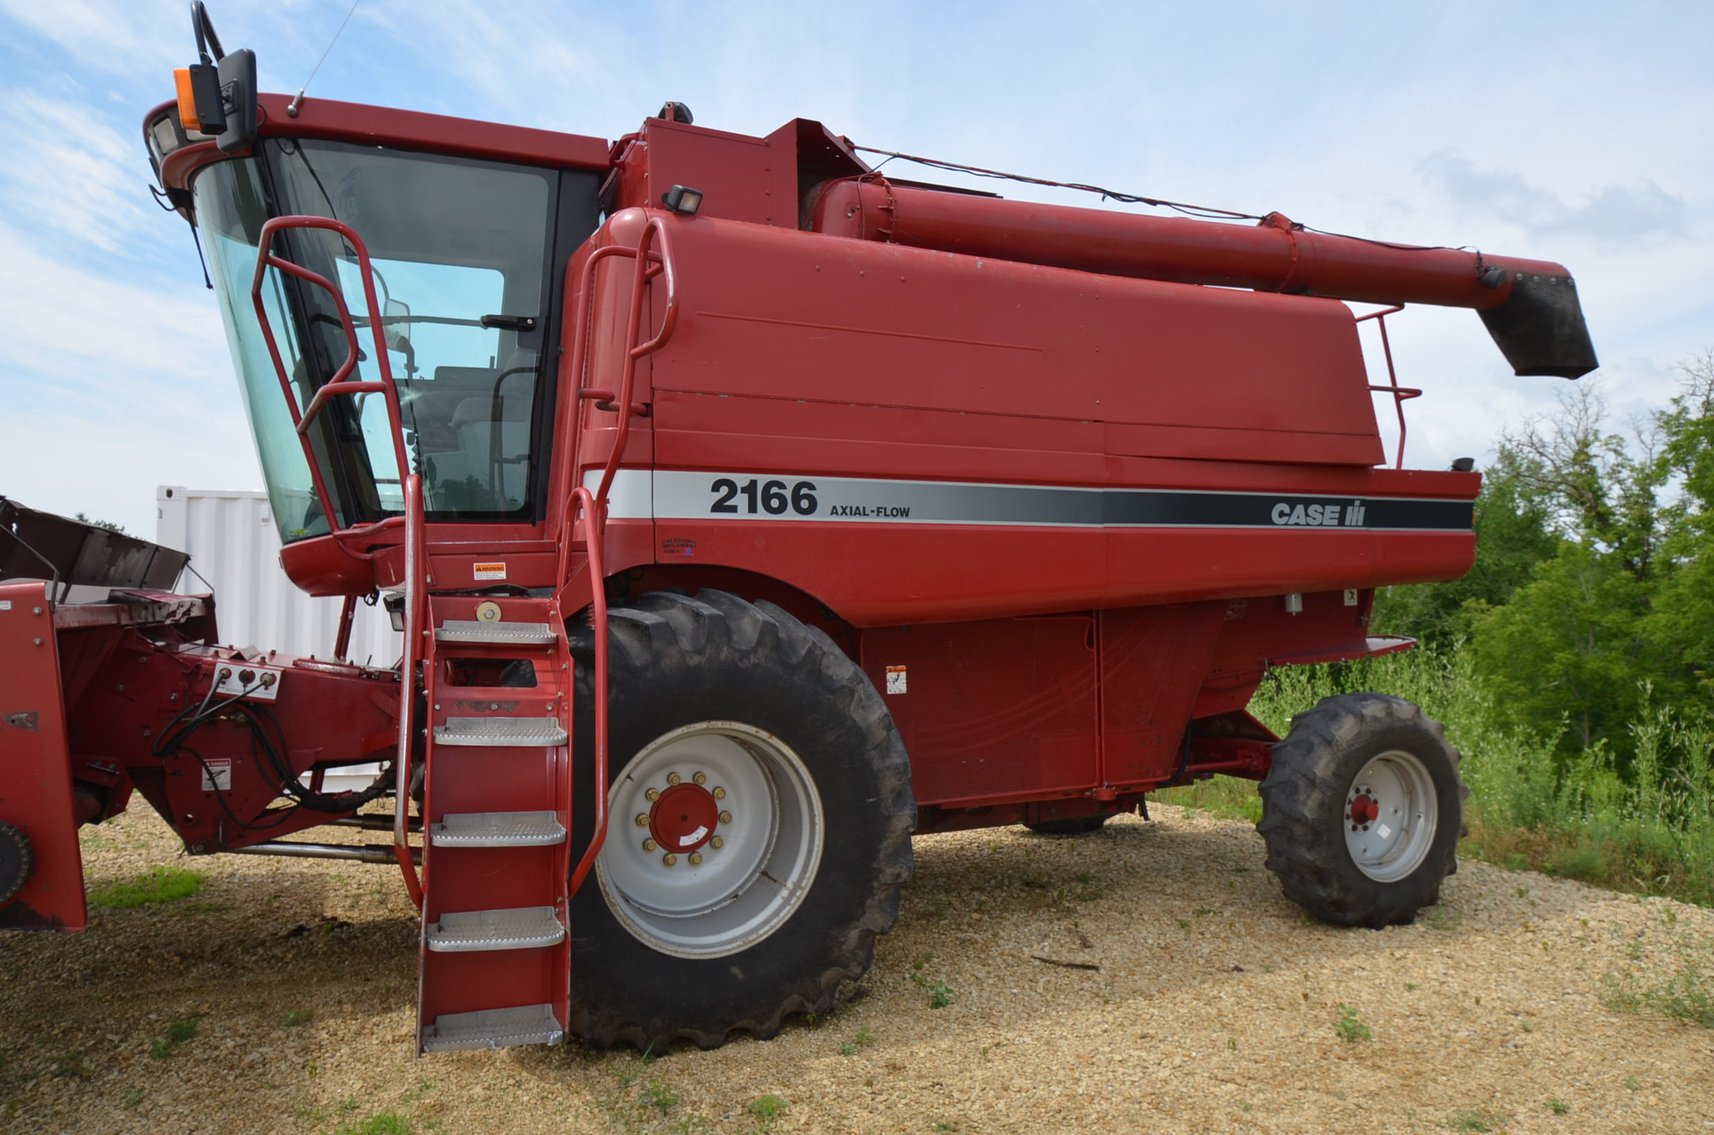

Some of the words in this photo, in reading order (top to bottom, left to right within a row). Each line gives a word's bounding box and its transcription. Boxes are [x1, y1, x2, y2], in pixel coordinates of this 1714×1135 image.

[710, 478, 818, 516] 2166
[830, 505, 911, 518] AXIAL-FLOW
[1271, 502, 1341, 526] CASE
